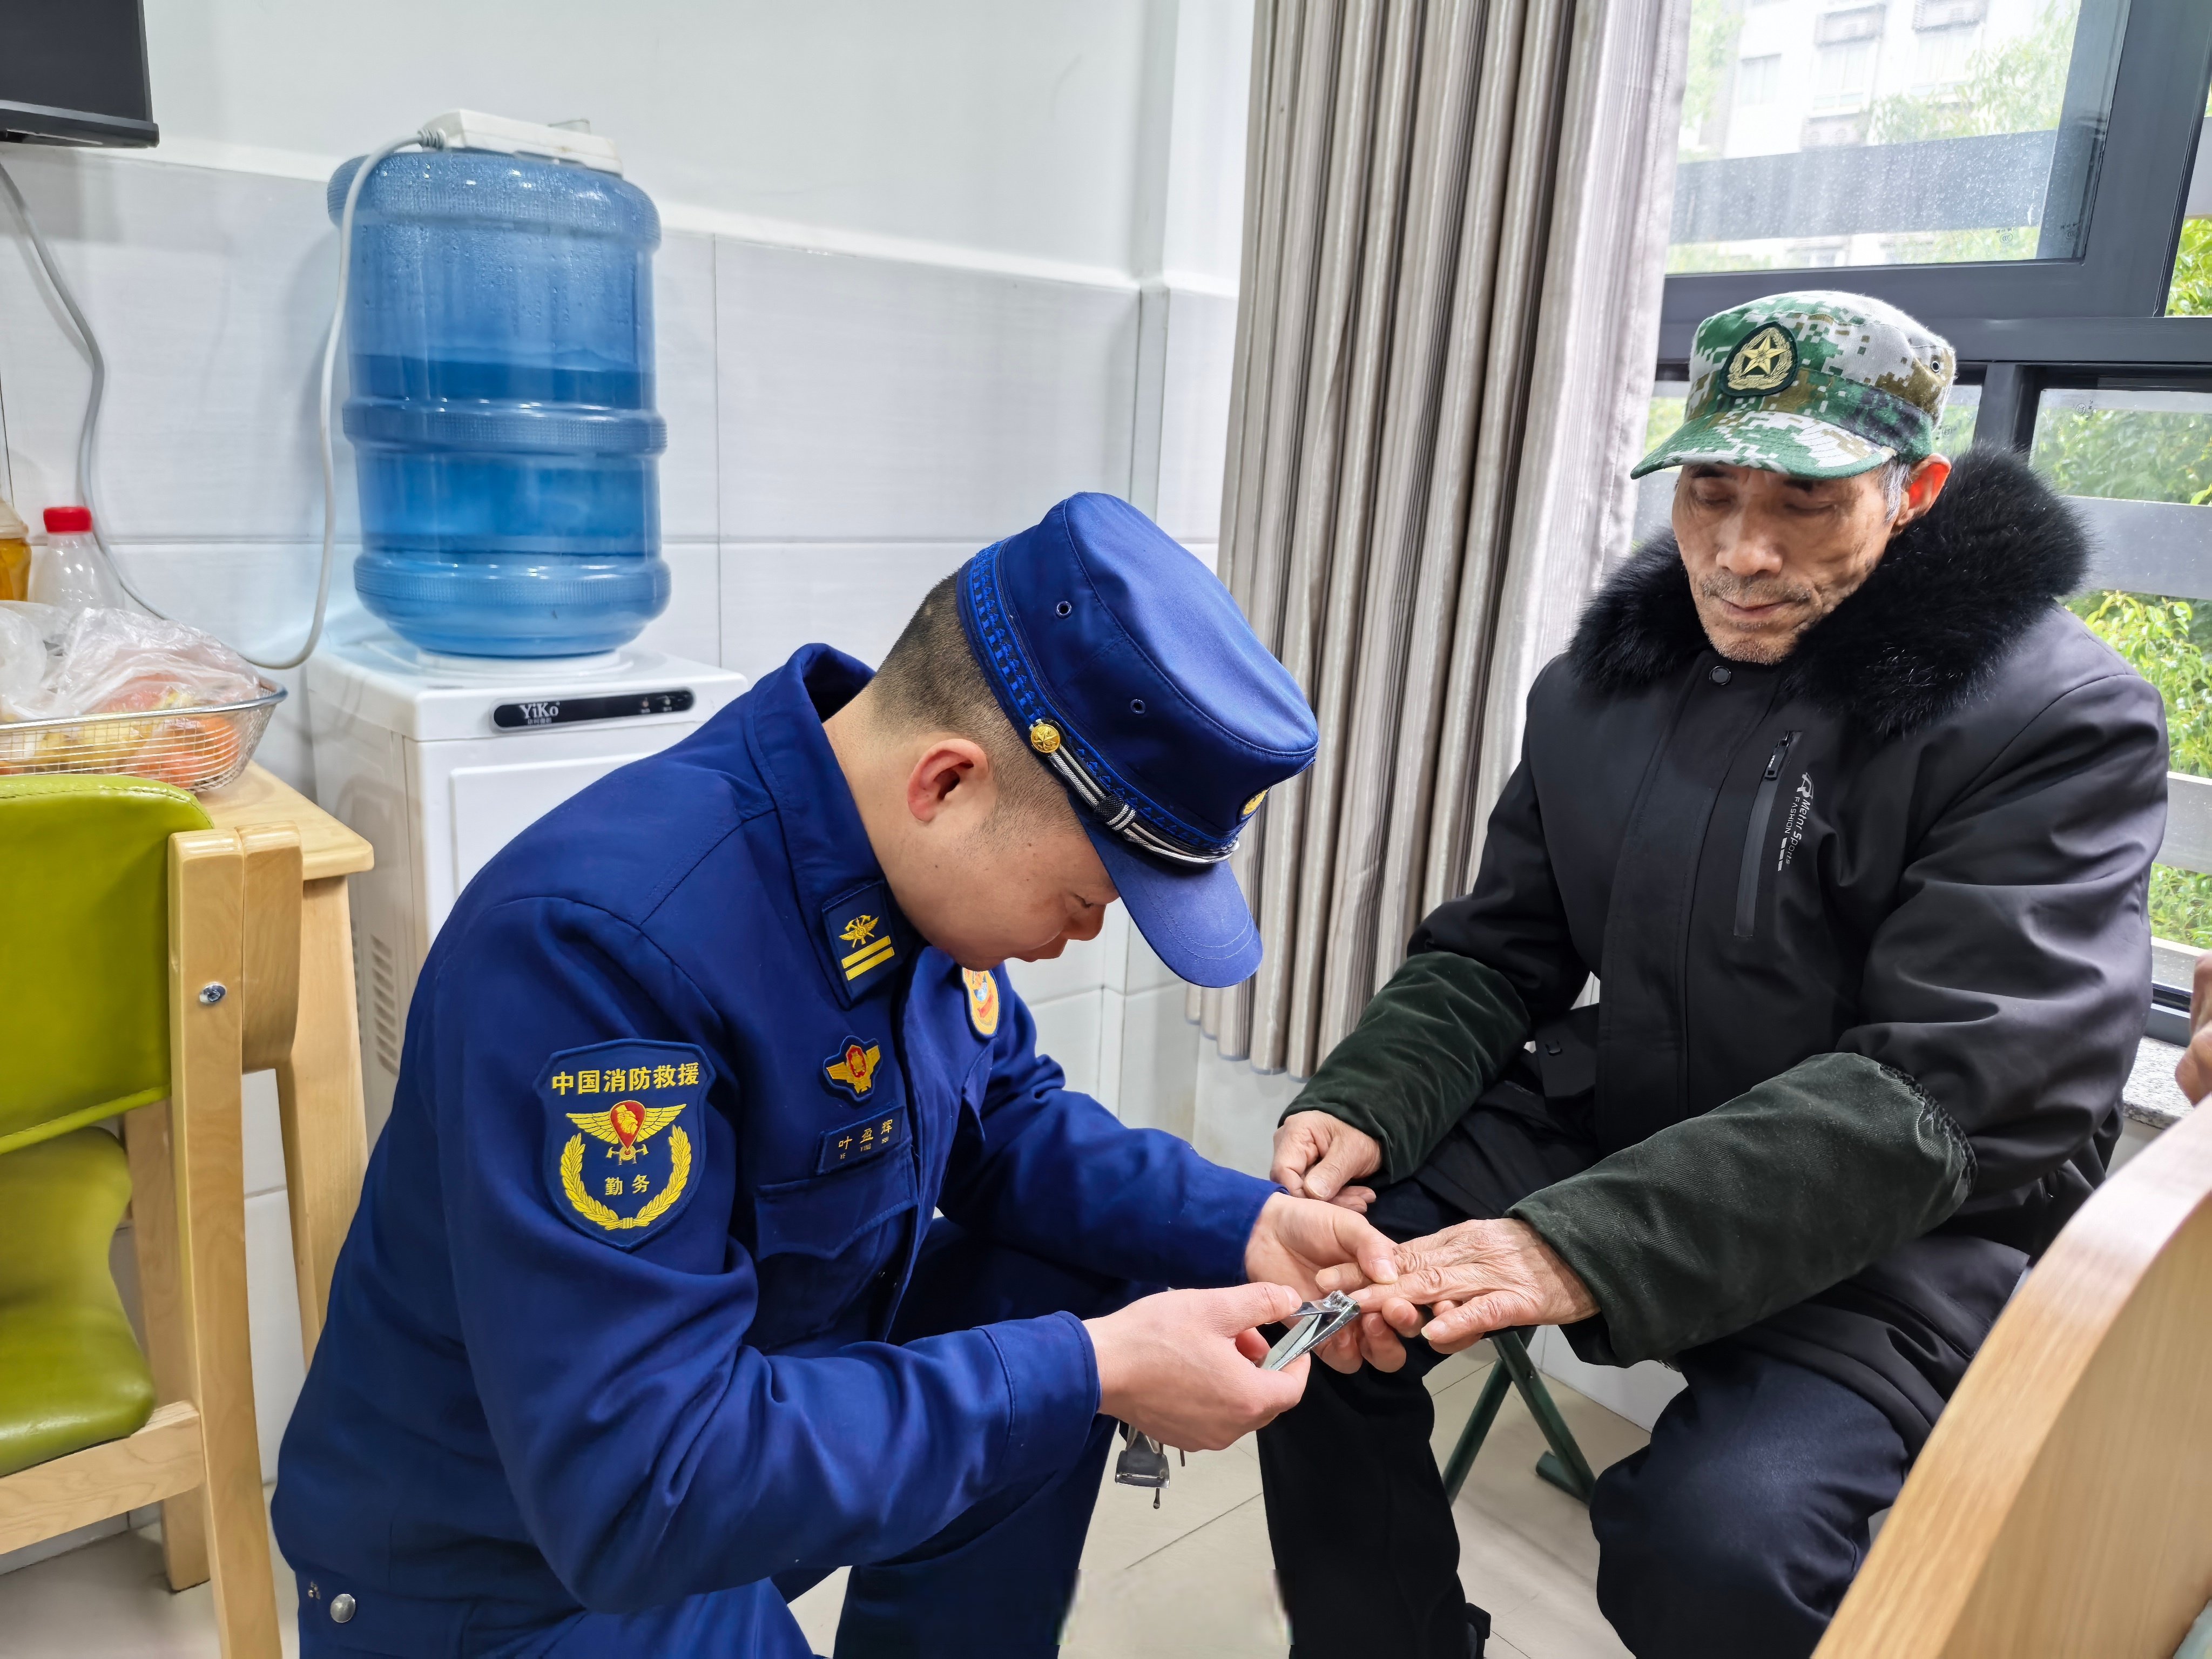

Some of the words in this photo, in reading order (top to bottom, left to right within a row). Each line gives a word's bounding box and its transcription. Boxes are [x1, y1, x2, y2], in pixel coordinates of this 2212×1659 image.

[519, 702, 559, 719] YiKo
[1784, 797, 1800, 834] FASHION
[1785, 831, 1802, 865] Sports
[551, 1062, 699, 1095] 中国消防救援
[604, 1174, 650, 1196] 勤务
